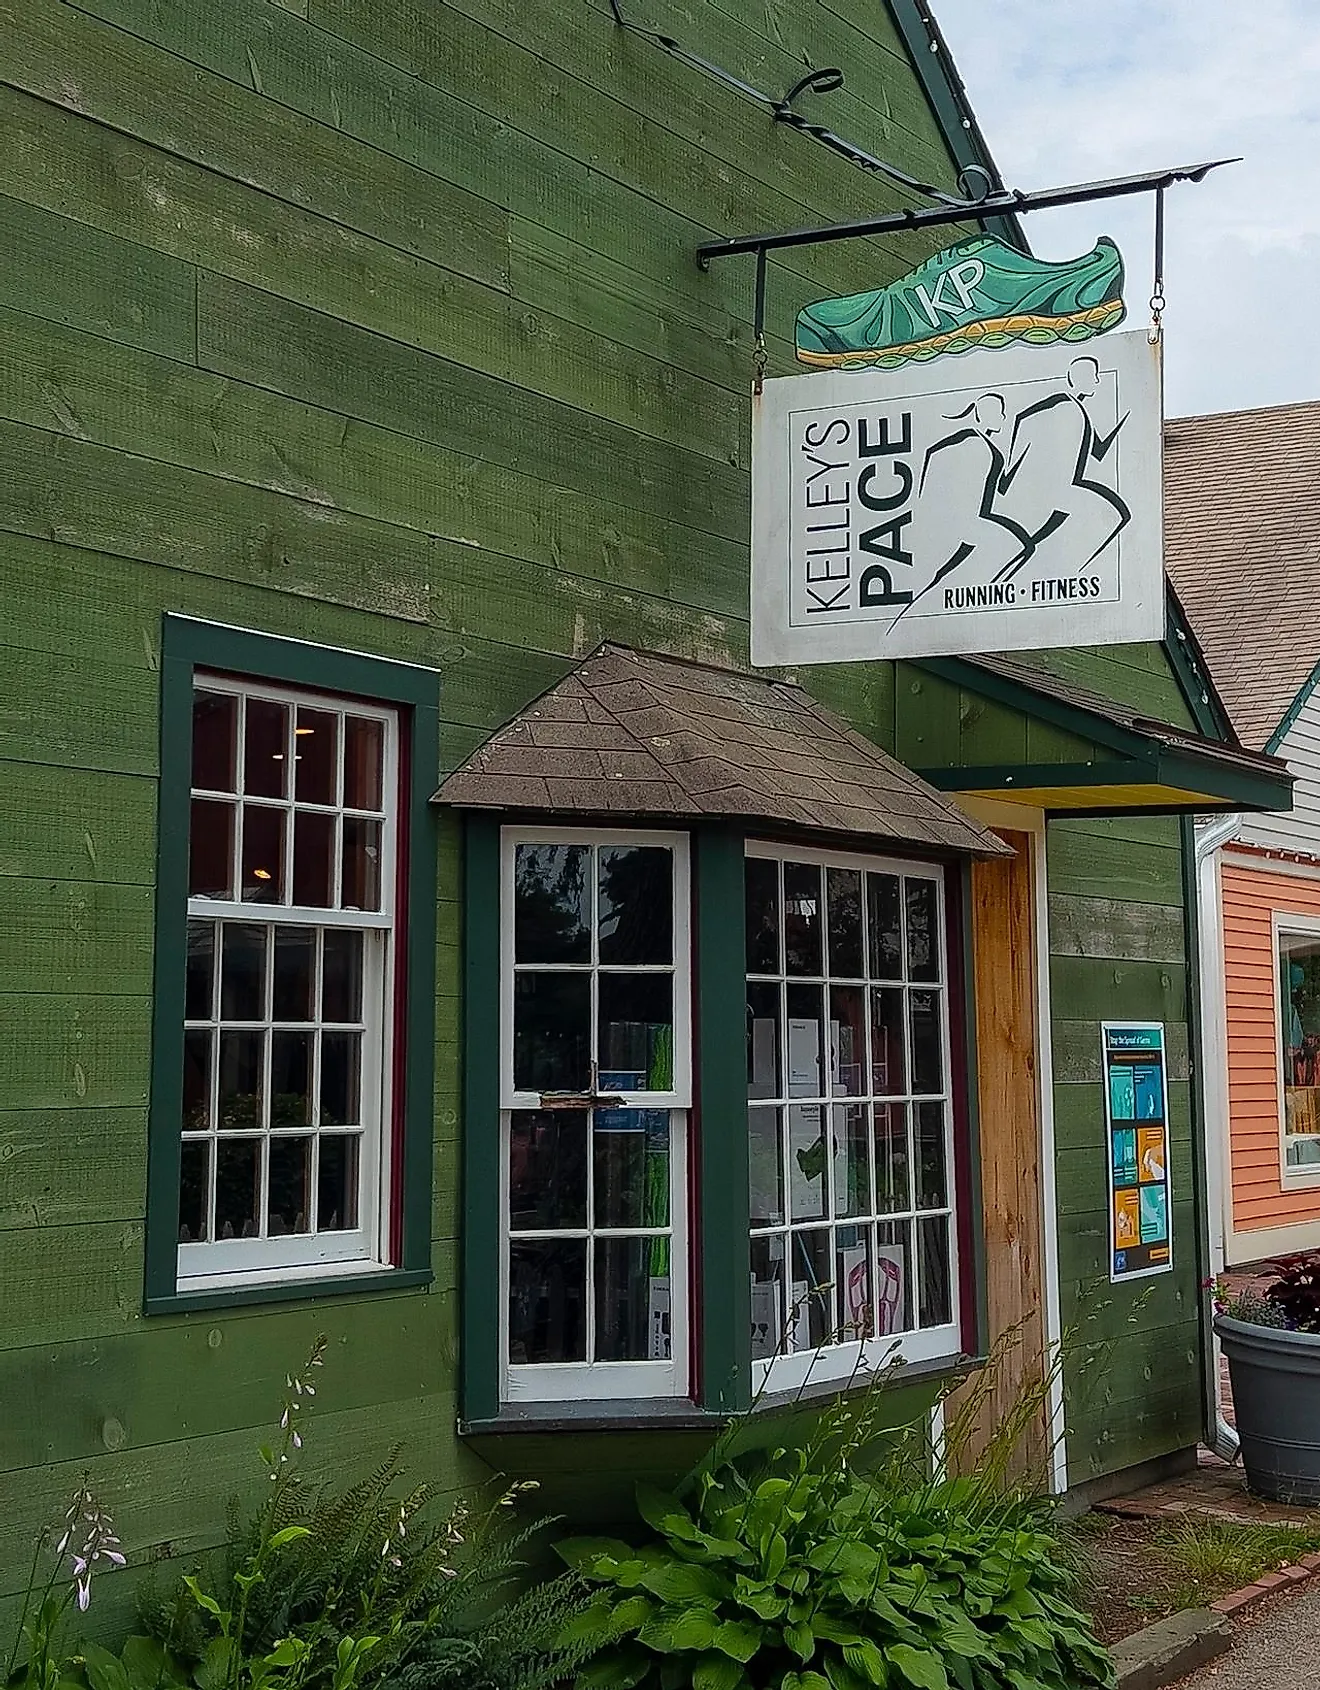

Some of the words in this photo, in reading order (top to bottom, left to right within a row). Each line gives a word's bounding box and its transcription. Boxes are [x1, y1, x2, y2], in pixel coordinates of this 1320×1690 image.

[914, 258, 984, 328] KP
[804, 418, 851, 614] KELLEY'S
[858, 411, 914, 608] PACE
[944, 583, 1016, 609] RUNNING
[1031, 576, 1100, 602] FITNESS
